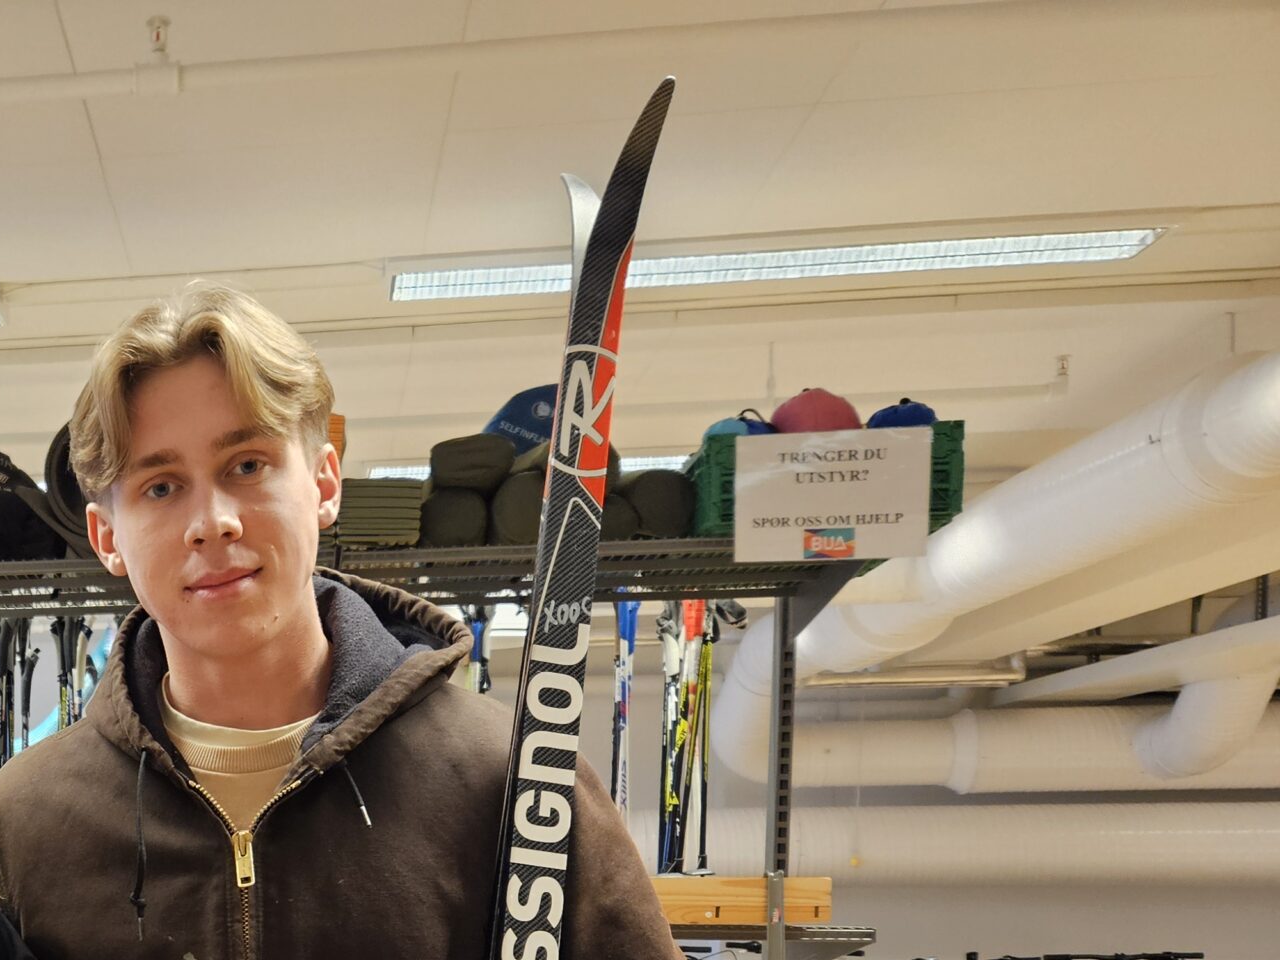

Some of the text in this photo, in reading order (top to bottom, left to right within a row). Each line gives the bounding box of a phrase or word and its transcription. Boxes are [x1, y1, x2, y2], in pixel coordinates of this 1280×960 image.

[778, 448, 888, 464] TRENGER DU
[795, 469, 870, 484] UTSTYR?
[752, 513, 905, 529] SPØR OSS OM HJELP
[811, 535, 848, 551] BUA
